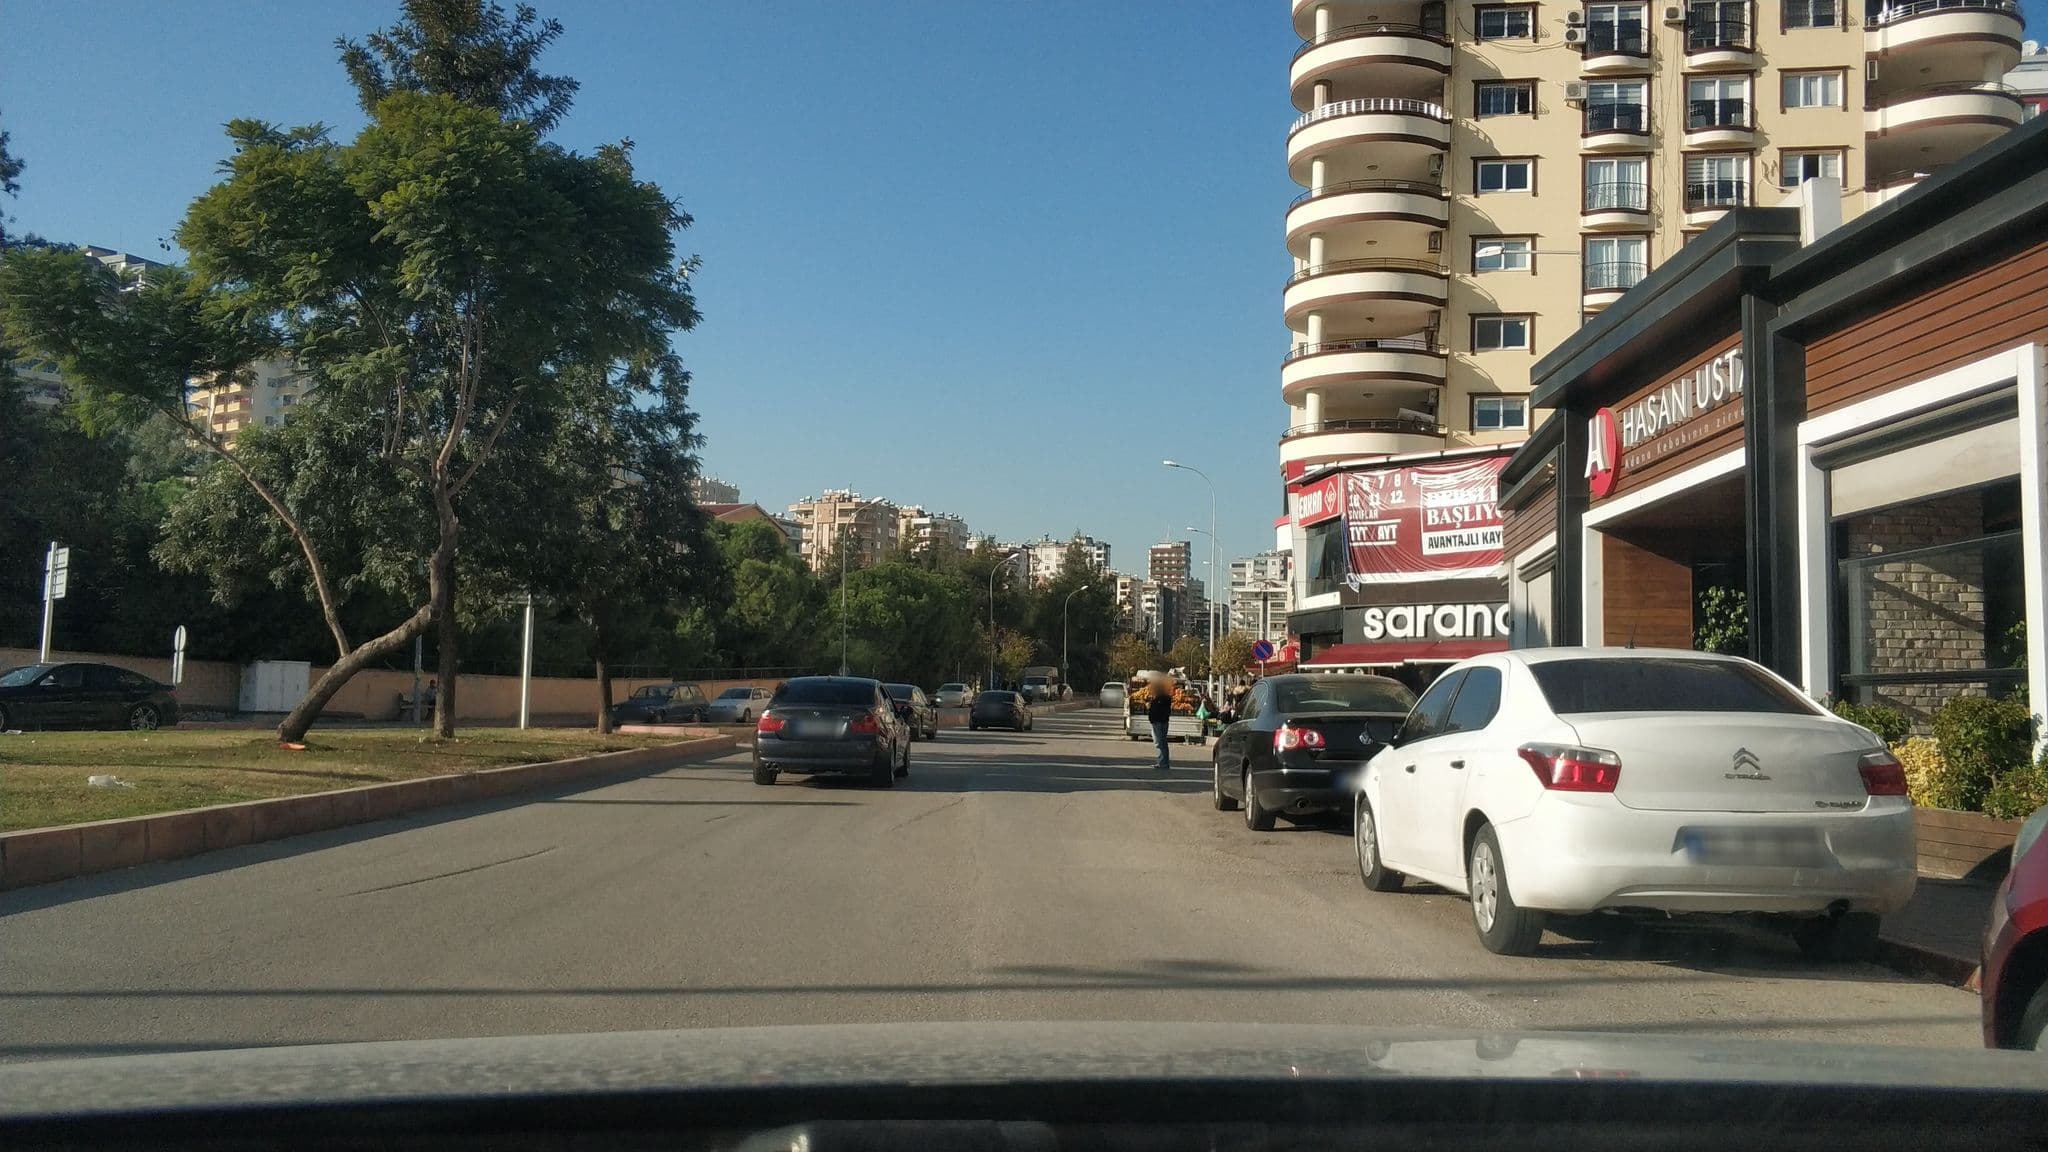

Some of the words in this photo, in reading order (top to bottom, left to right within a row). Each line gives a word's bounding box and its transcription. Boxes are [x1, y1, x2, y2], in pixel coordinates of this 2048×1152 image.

[1623, 378, 1690, 447] HASAN
[1378, 524, 1398, 540] AYT
[1428, 532, 1479, 550] AVANTAJLI
